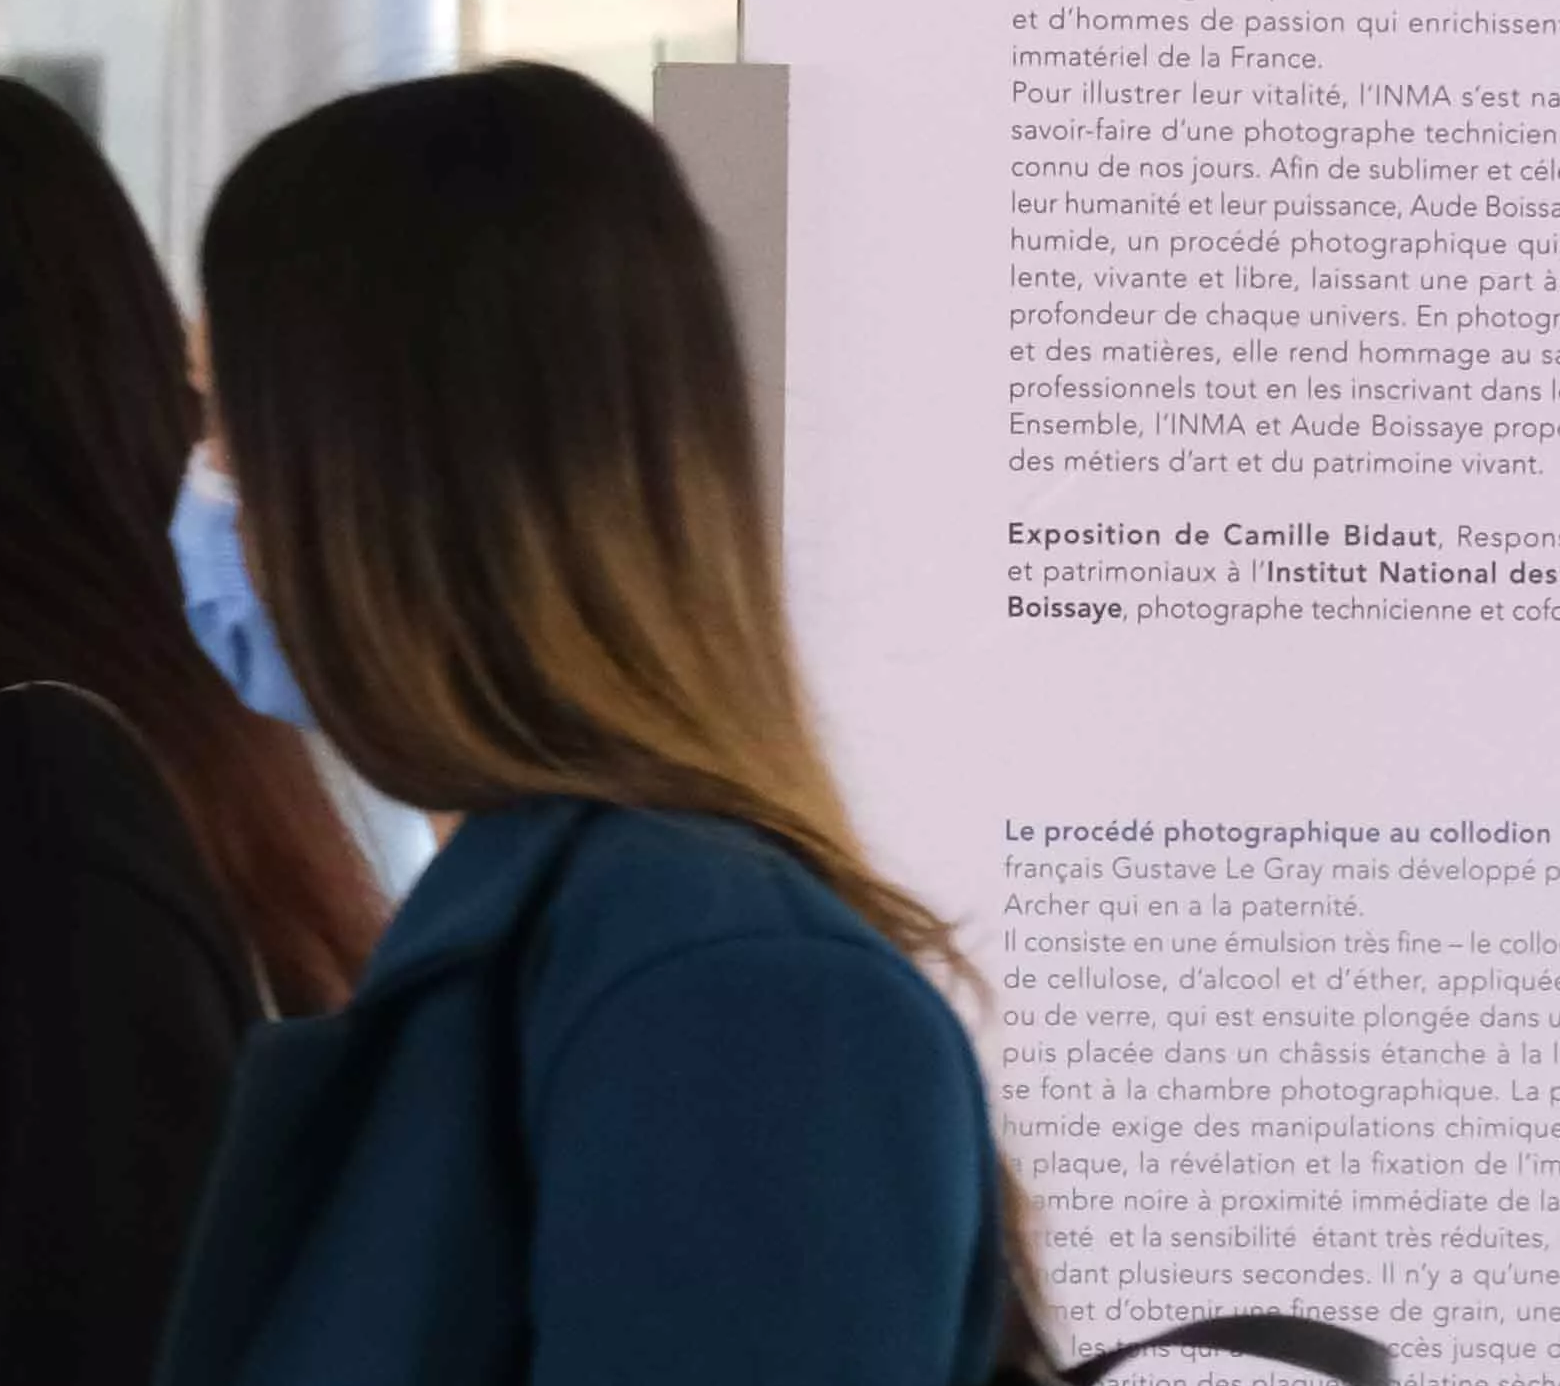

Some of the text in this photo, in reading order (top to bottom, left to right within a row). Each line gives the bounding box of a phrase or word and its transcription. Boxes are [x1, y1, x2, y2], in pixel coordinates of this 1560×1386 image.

[1013, 43, 1323, 69] immatériel de la France.
[1010, 301, 1447, 333] profondeur de chaque univers. En
[1009, 446, 1543, 480] des métiers d'art et du patrimoine vivant.
[1009, 521, 1443, 551] Exposition de Camille Bidaut,
[1008, 558, 1557, 588] et patrimoniaux à l'Institut National des
[1008, 594, 1504, 626] Boissaye, photographe technicienne et
[1006, 818, 1550, 849] Le procédé photographique au collodion
[1004, 891, 1364, 922] Archer qui en a la paternité.
[1112, 1116, 1183, 1143] exige
[1194, 1113, 1240, 1137] des
[1251, 1114, 1434, 1144] manipulations
[1124, 1187, 1529, 1217] noire à proximité immédiate de
